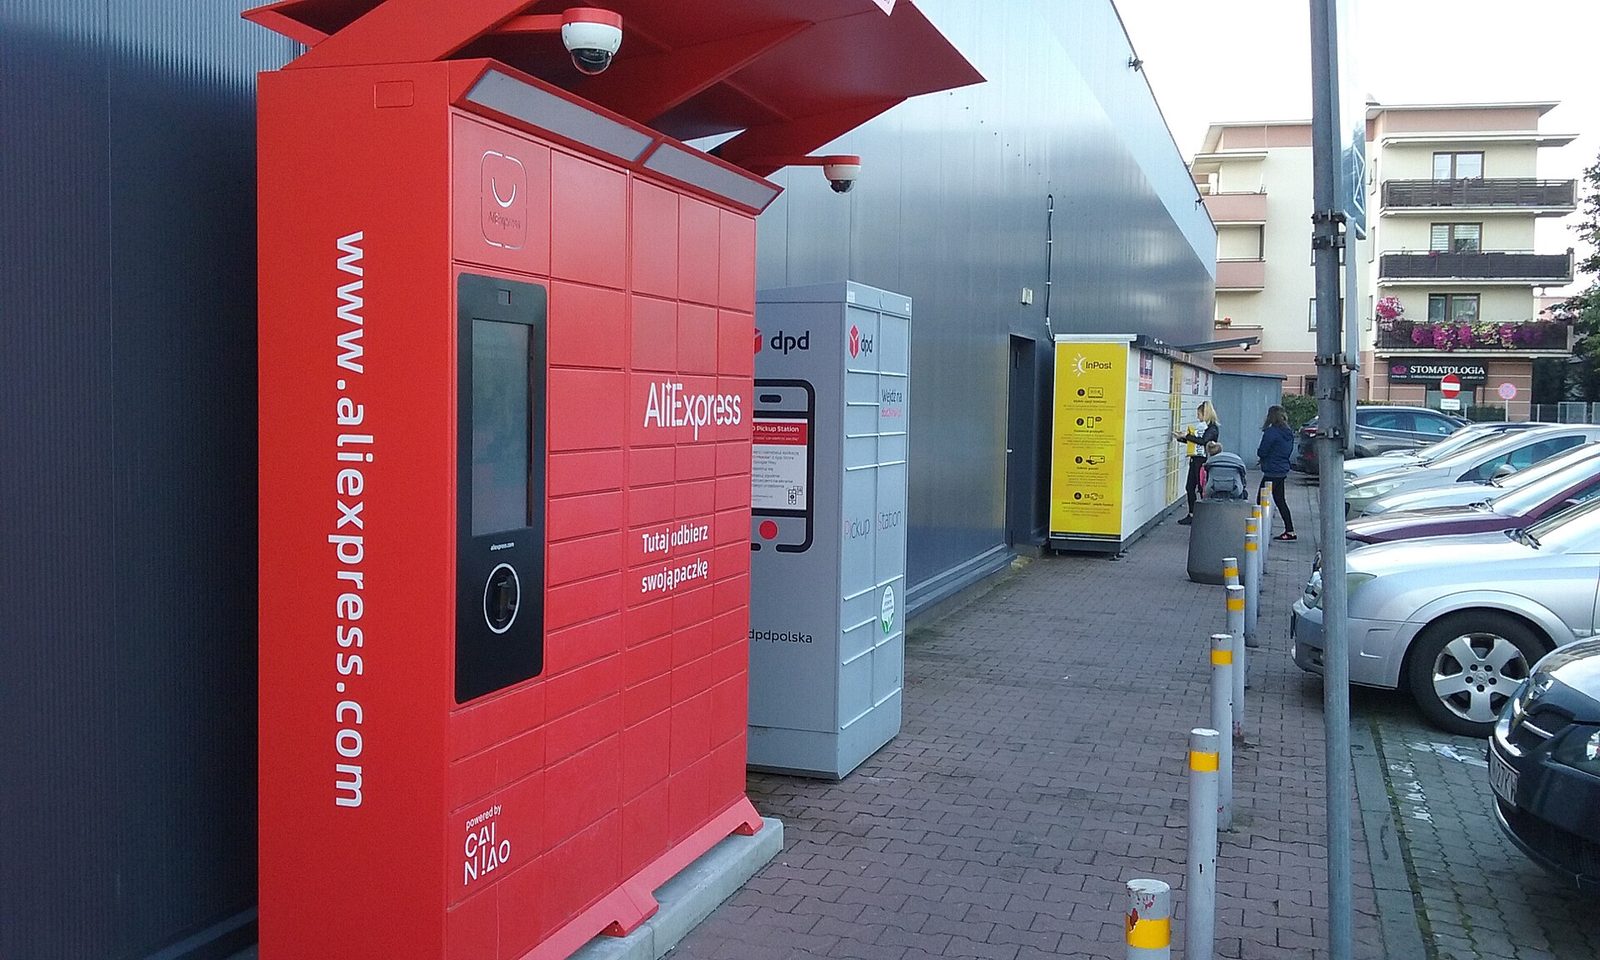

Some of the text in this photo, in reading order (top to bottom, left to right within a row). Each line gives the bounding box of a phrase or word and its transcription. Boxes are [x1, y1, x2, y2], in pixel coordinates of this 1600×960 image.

[770, 330, 810, 355] dpd
[860, 333, 874, 357] dpd
[1085, 361, 1112, 370] InPost
[1410, 365, 1485, 375] STOMATOLOGIA
[643, 378, 741, 441] AliExpress
[756, 425, 800, 433] Pickup Station
[328, 231, 374, 807] www.aliexpress.com
[844, 510, 902, 541] Pickup Station
[642, 523, 708, 554] Tutaj odbierz
[641, 557, 708, 593] swoją paczkę
[465, 804, 502, 832] powered by
[465, 821, 495, 858] CAI
